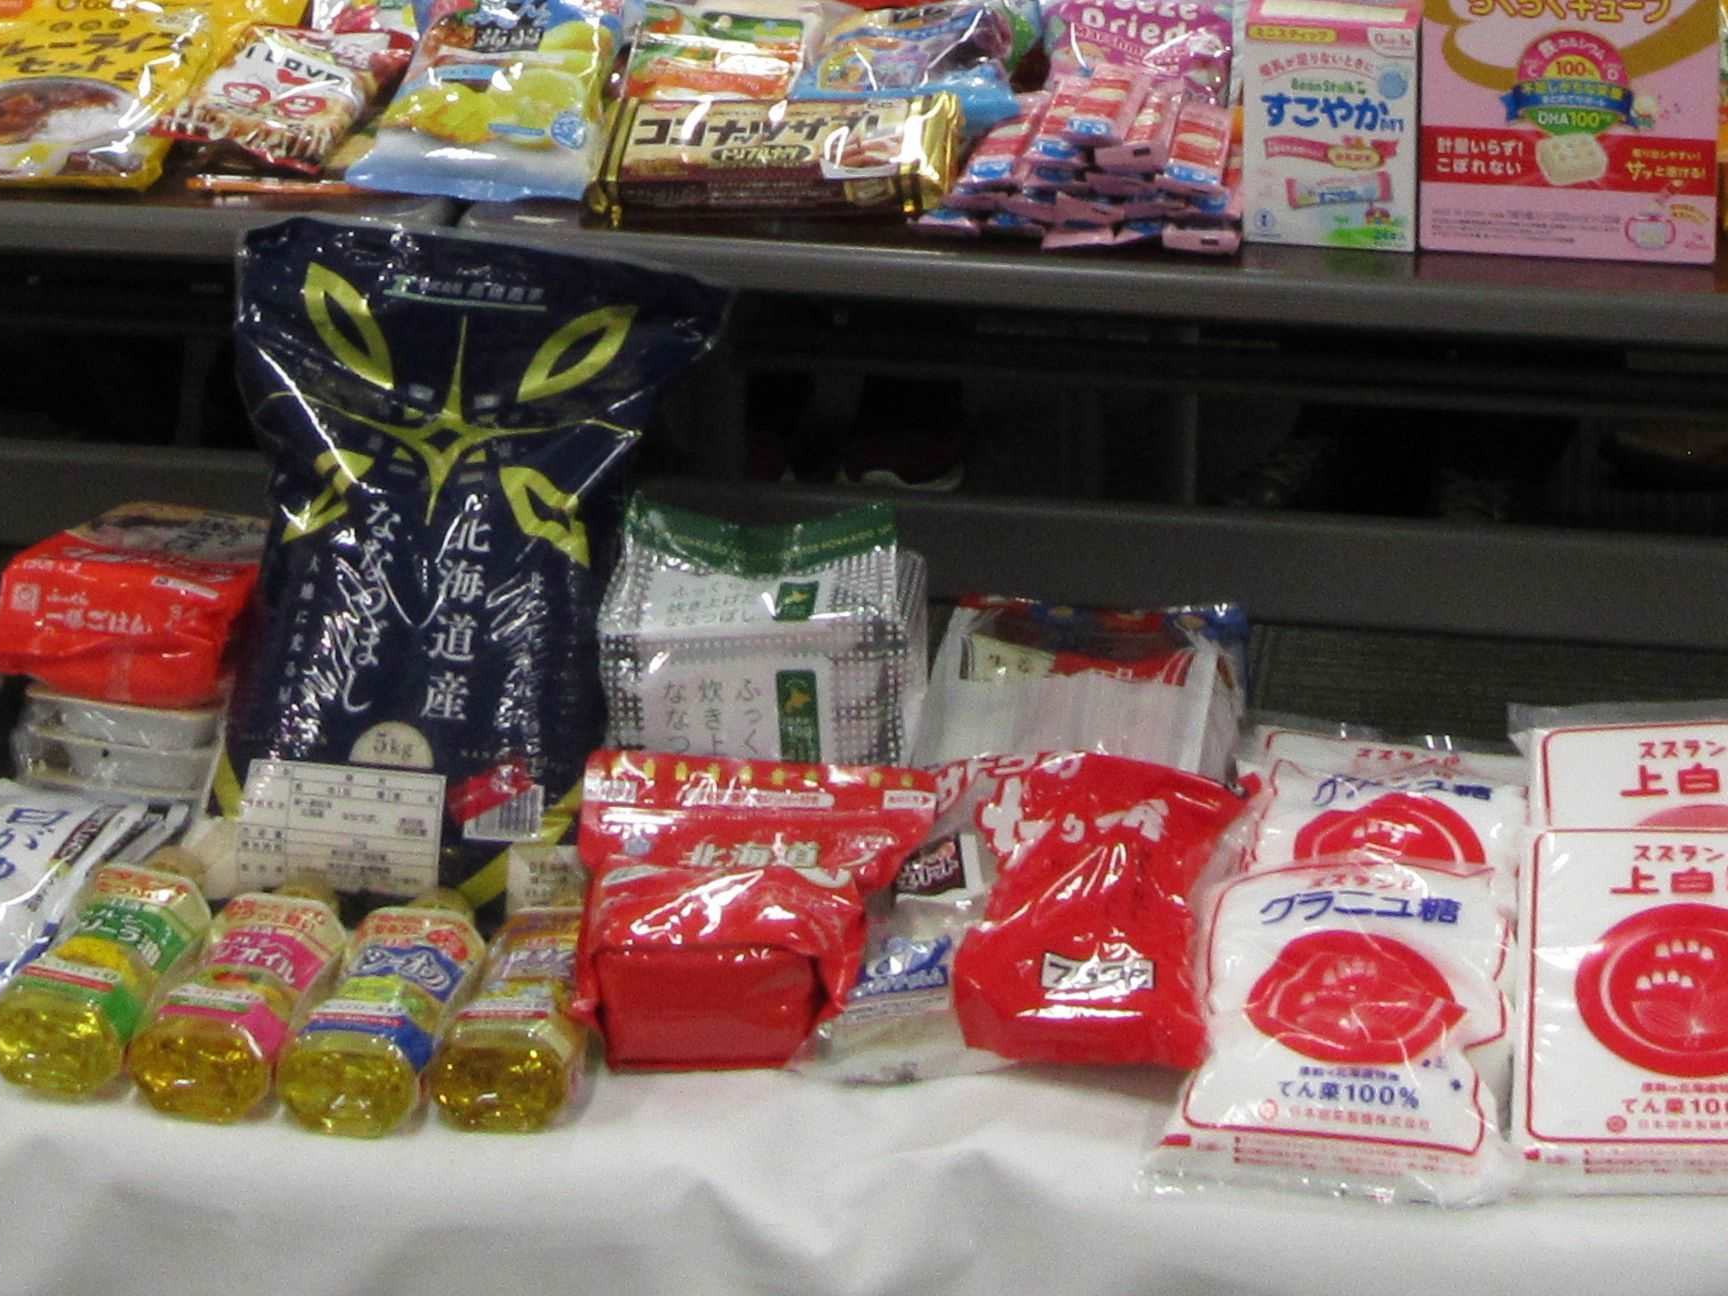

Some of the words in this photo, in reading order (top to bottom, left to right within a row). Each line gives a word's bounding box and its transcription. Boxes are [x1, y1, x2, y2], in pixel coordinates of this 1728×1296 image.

[14, 53, 117, 75] セット
[1260, 91, 1390, 132] すこやか
[1436, 158, 1522, 176] こぼれない
[417, 511, 494, 723] 北海道産
[663, 679, 691, 754] ななつ
[699, 678, 723, 756] 炊き上
[735, 677, 763, 755] ふっく
[371, 734, 417, 763] 5kg
[1258, 893, 1464, 928] グラニュ糖
